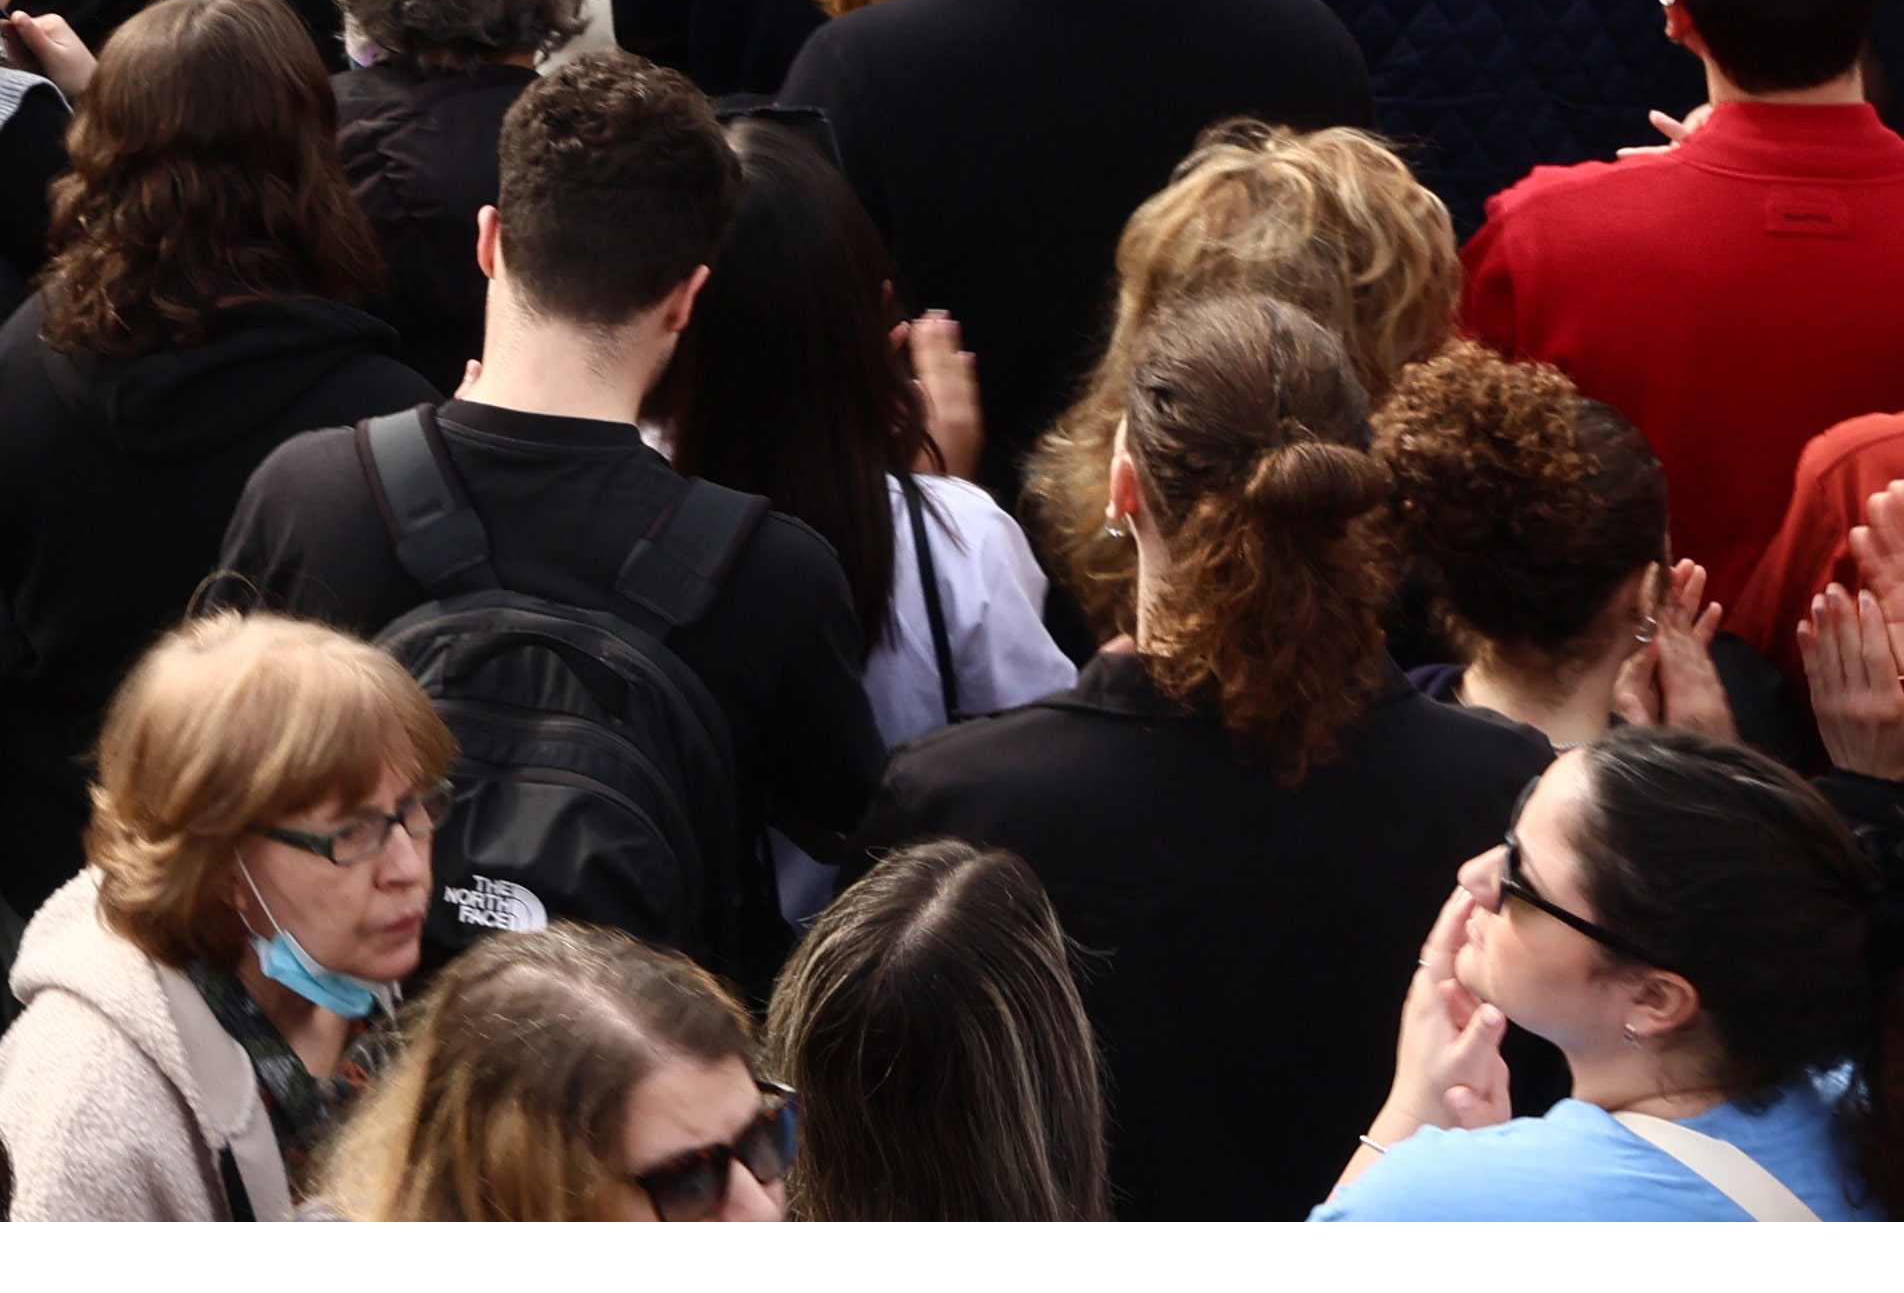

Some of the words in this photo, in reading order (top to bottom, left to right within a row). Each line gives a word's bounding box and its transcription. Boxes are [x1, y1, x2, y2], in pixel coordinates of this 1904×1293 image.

[472, 875, 513, 896] THE
[443, 886, 510, 914] NORTH
[458, 905, 510, 930] FACE
